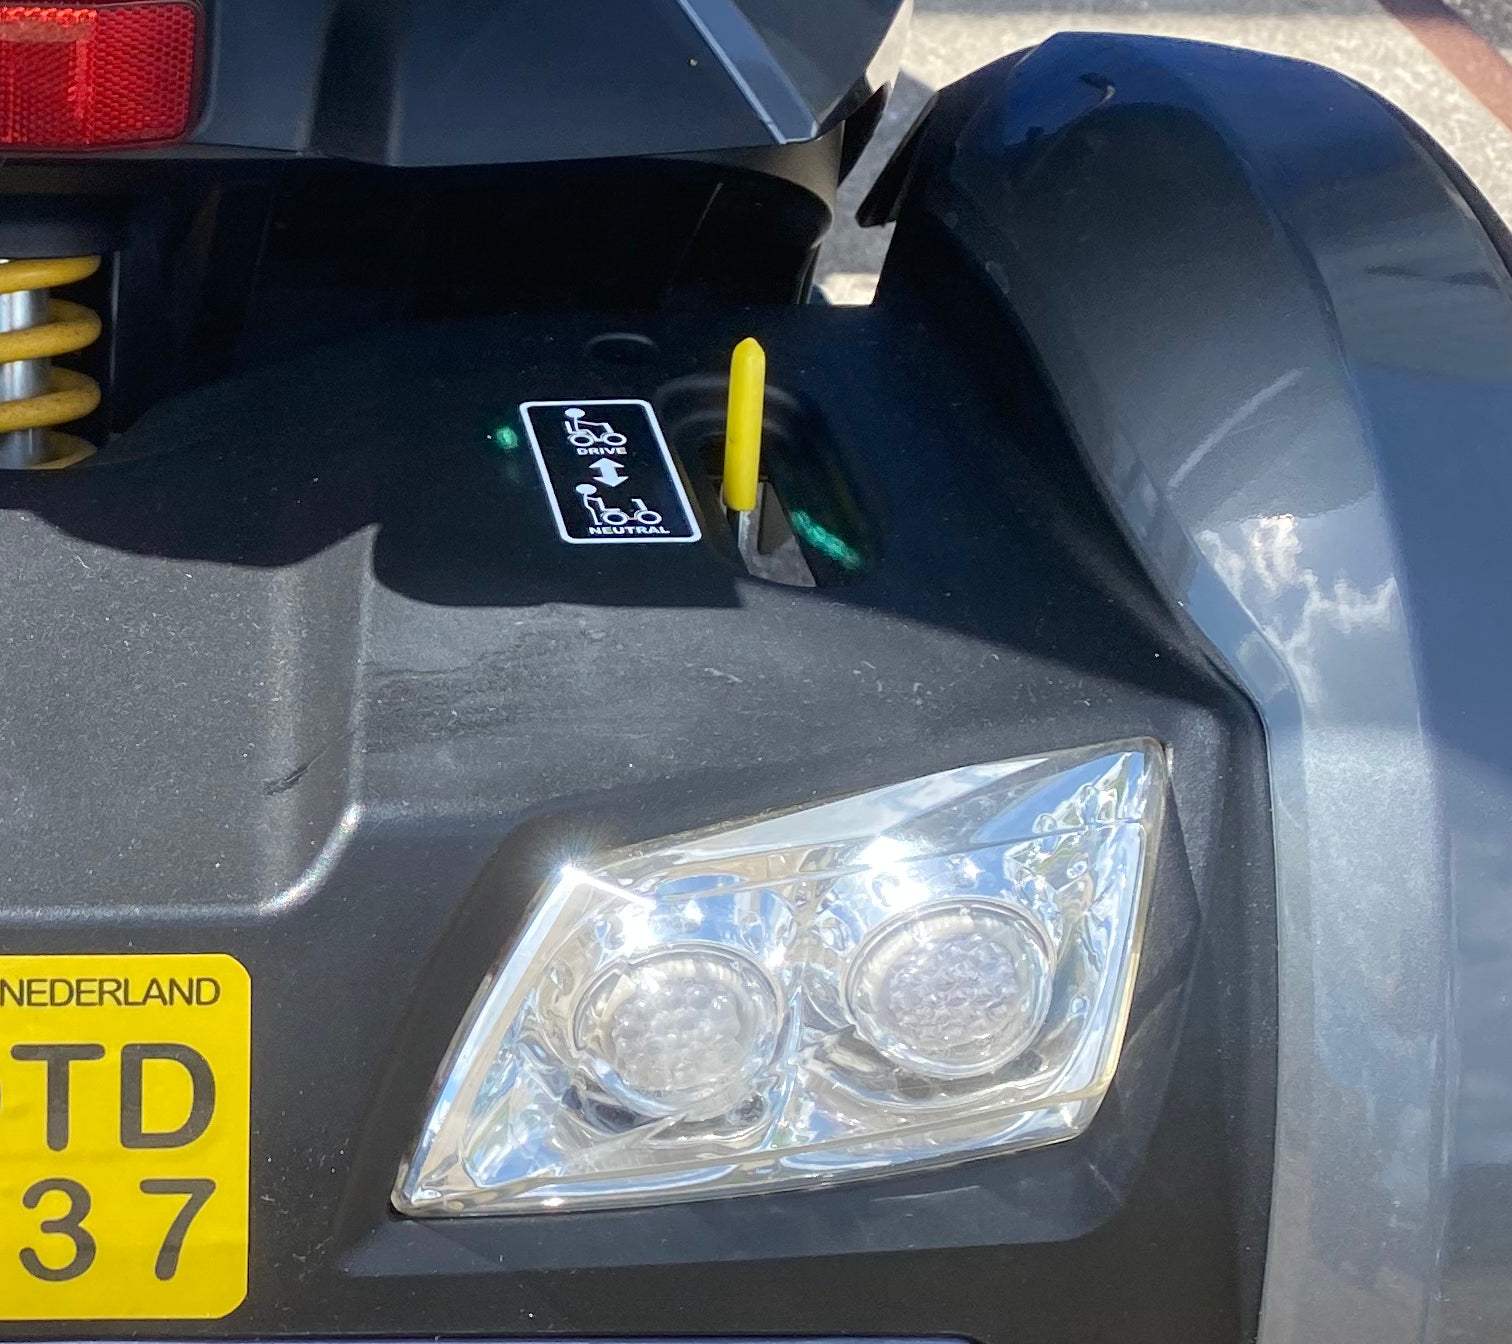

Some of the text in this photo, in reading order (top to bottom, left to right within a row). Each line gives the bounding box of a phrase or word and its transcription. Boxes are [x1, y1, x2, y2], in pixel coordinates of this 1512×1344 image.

[576, 447, 628, 455] DRIVE
[588, 525, 671, 535] NEUTRAL
[0, 977, 221, 1007] NEDERLAND
